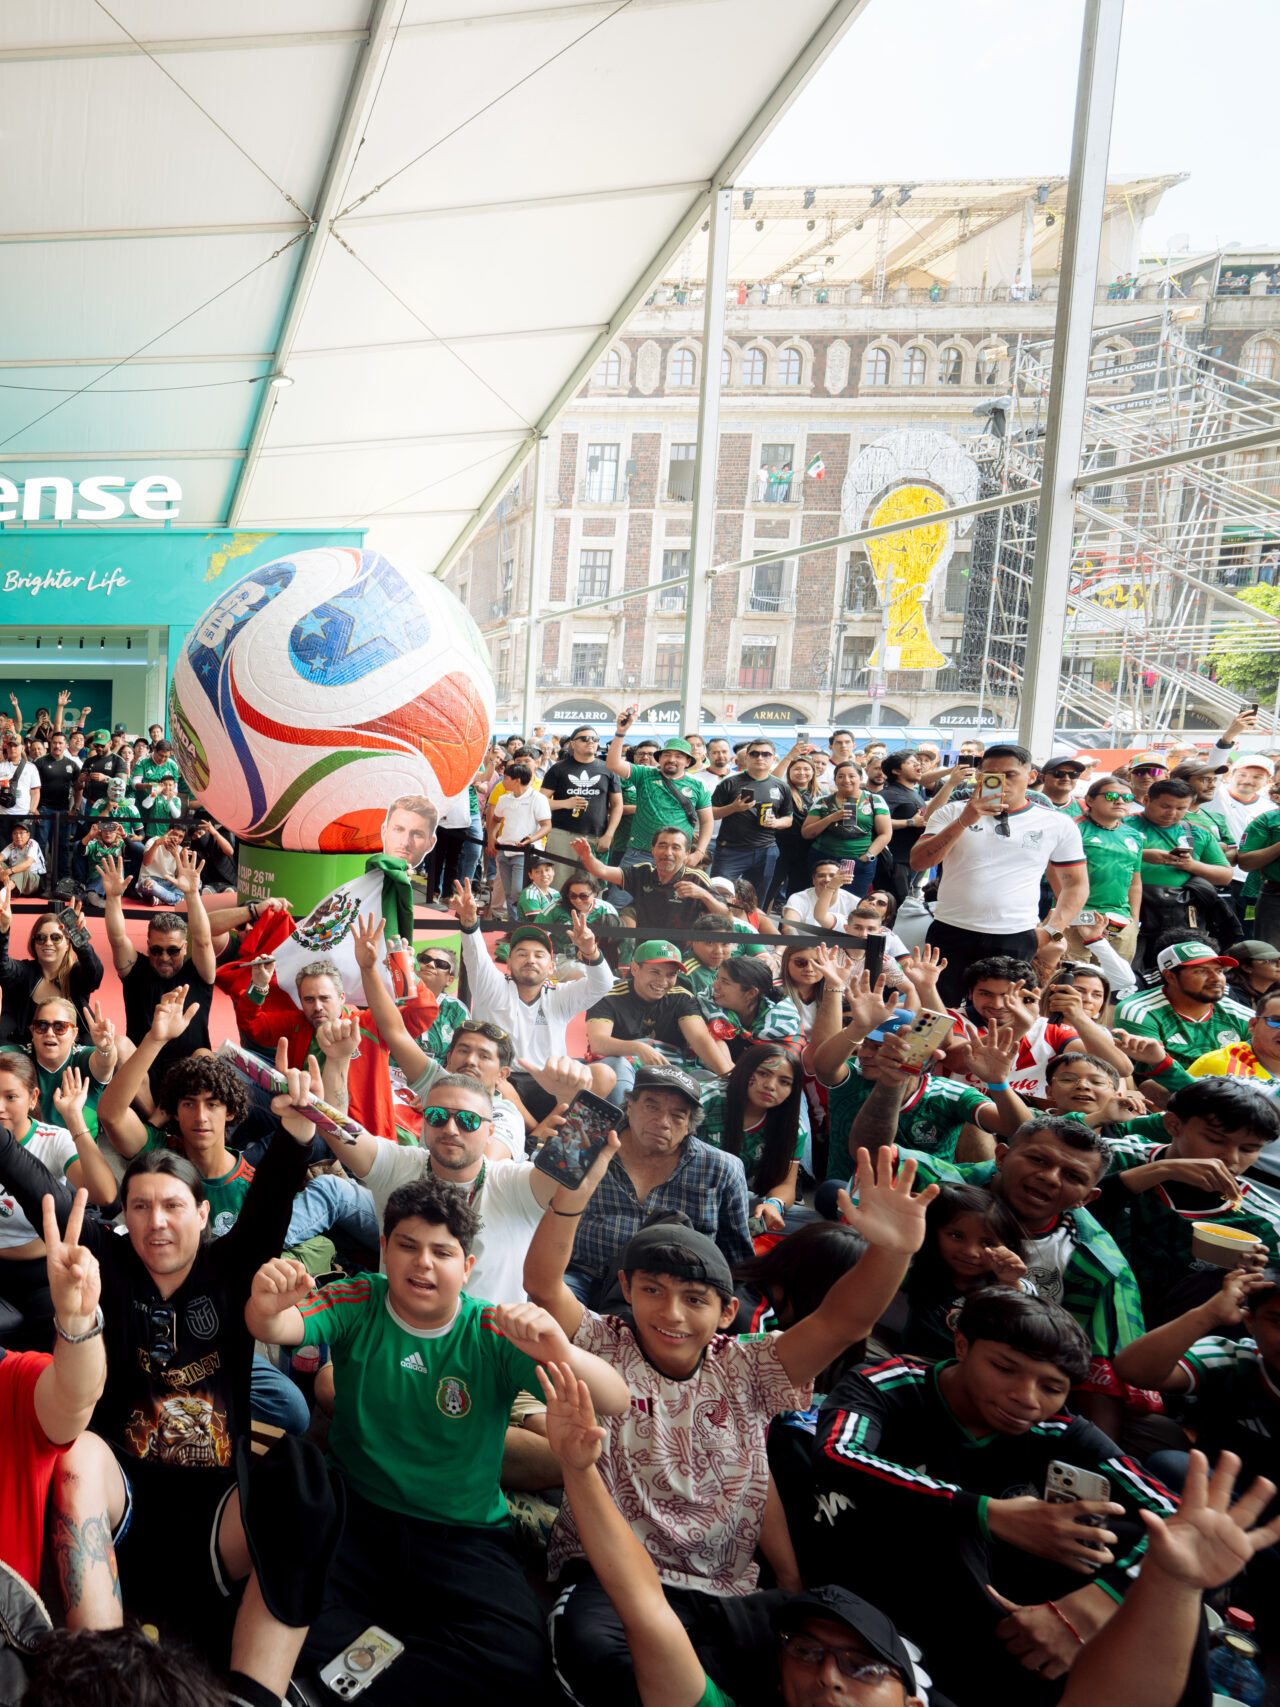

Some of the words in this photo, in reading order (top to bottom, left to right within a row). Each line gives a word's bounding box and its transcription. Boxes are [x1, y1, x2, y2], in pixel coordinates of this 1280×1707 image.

[2, 570, 85, 595] Brighter
[87, 567, 131, 595] Life
[553, 711, 608, 721] BIZZARRO
[753, 711, 791, 720] ARMANI
[939, 716, 995, 726] BIZZARRO
[566, 787, 601, 796] adidas
[240, 866, 252, 881] CUP
[400, 1360, 428, 1374] adidas
